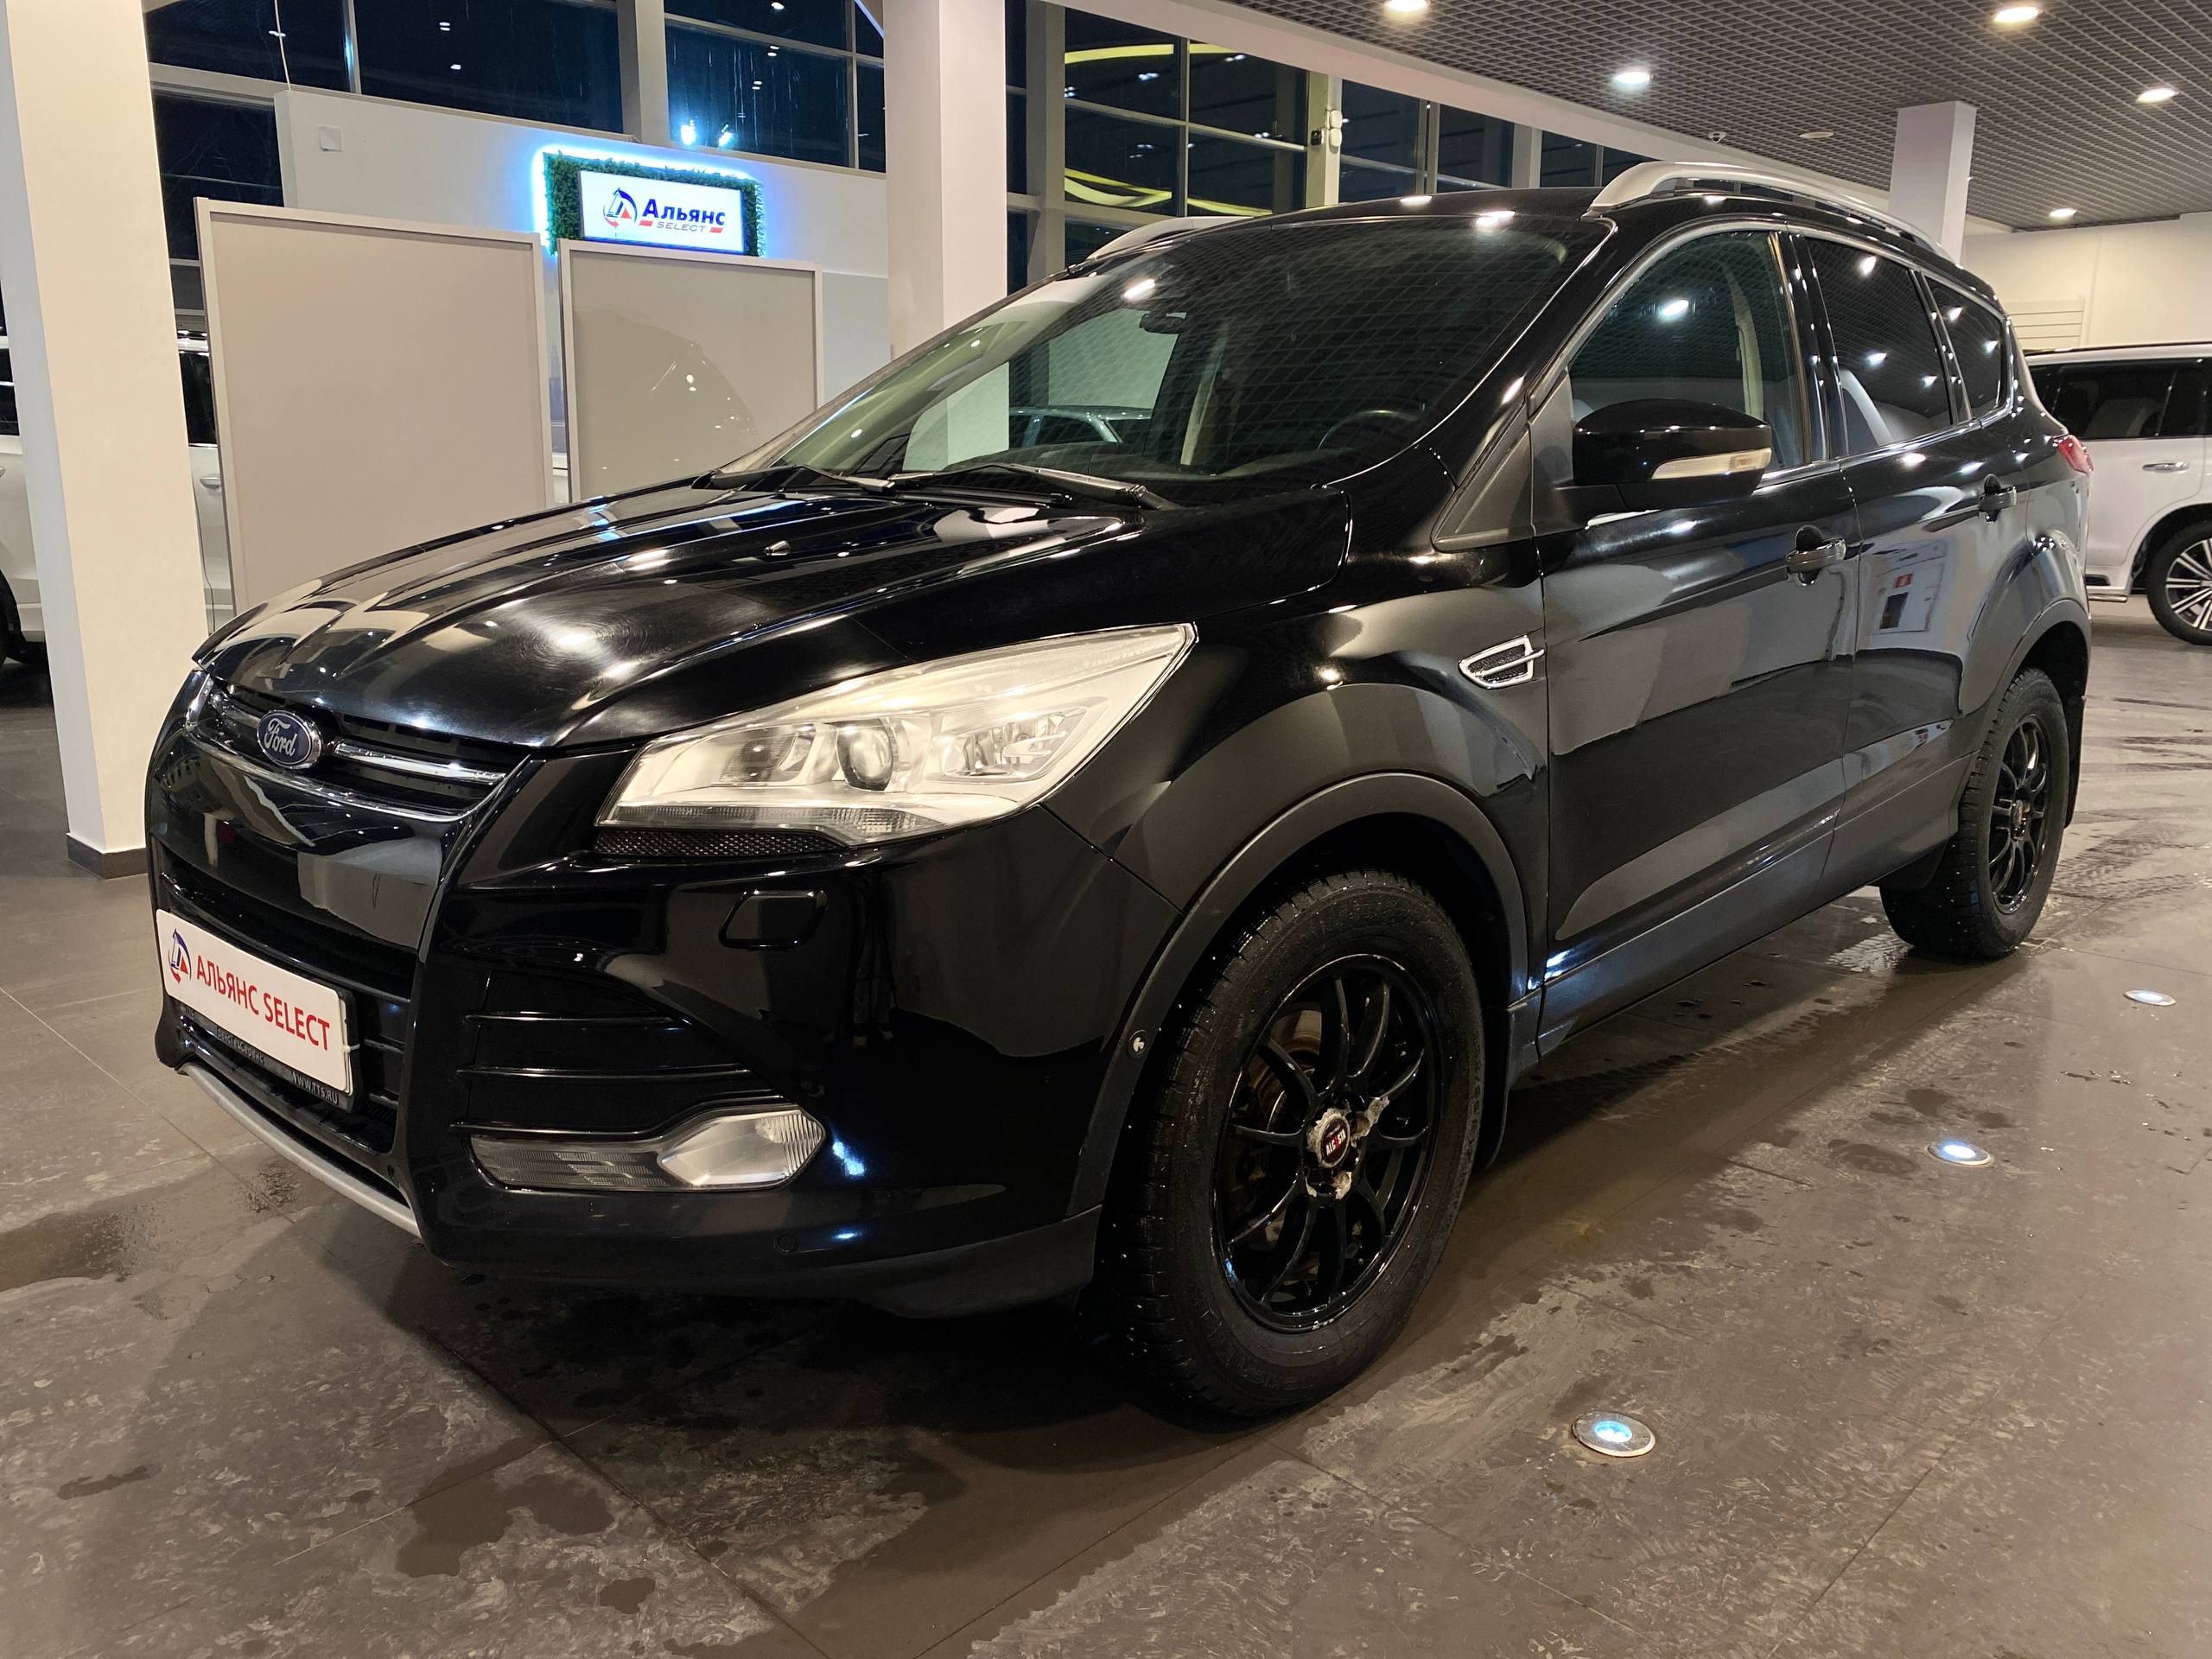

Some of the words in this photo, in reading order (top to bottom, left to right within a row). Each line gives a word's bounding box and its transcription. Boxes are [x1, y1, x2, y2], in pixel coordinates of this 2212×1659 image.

[642, 198, 726, 226] Альянс
[657, 221, 707, 232] SELECT
[264, 718, 298, 756] Ford
[196, 955, 259, 1015] АЛЬЯНС
[264, 992, 330, 1051] SELECT
